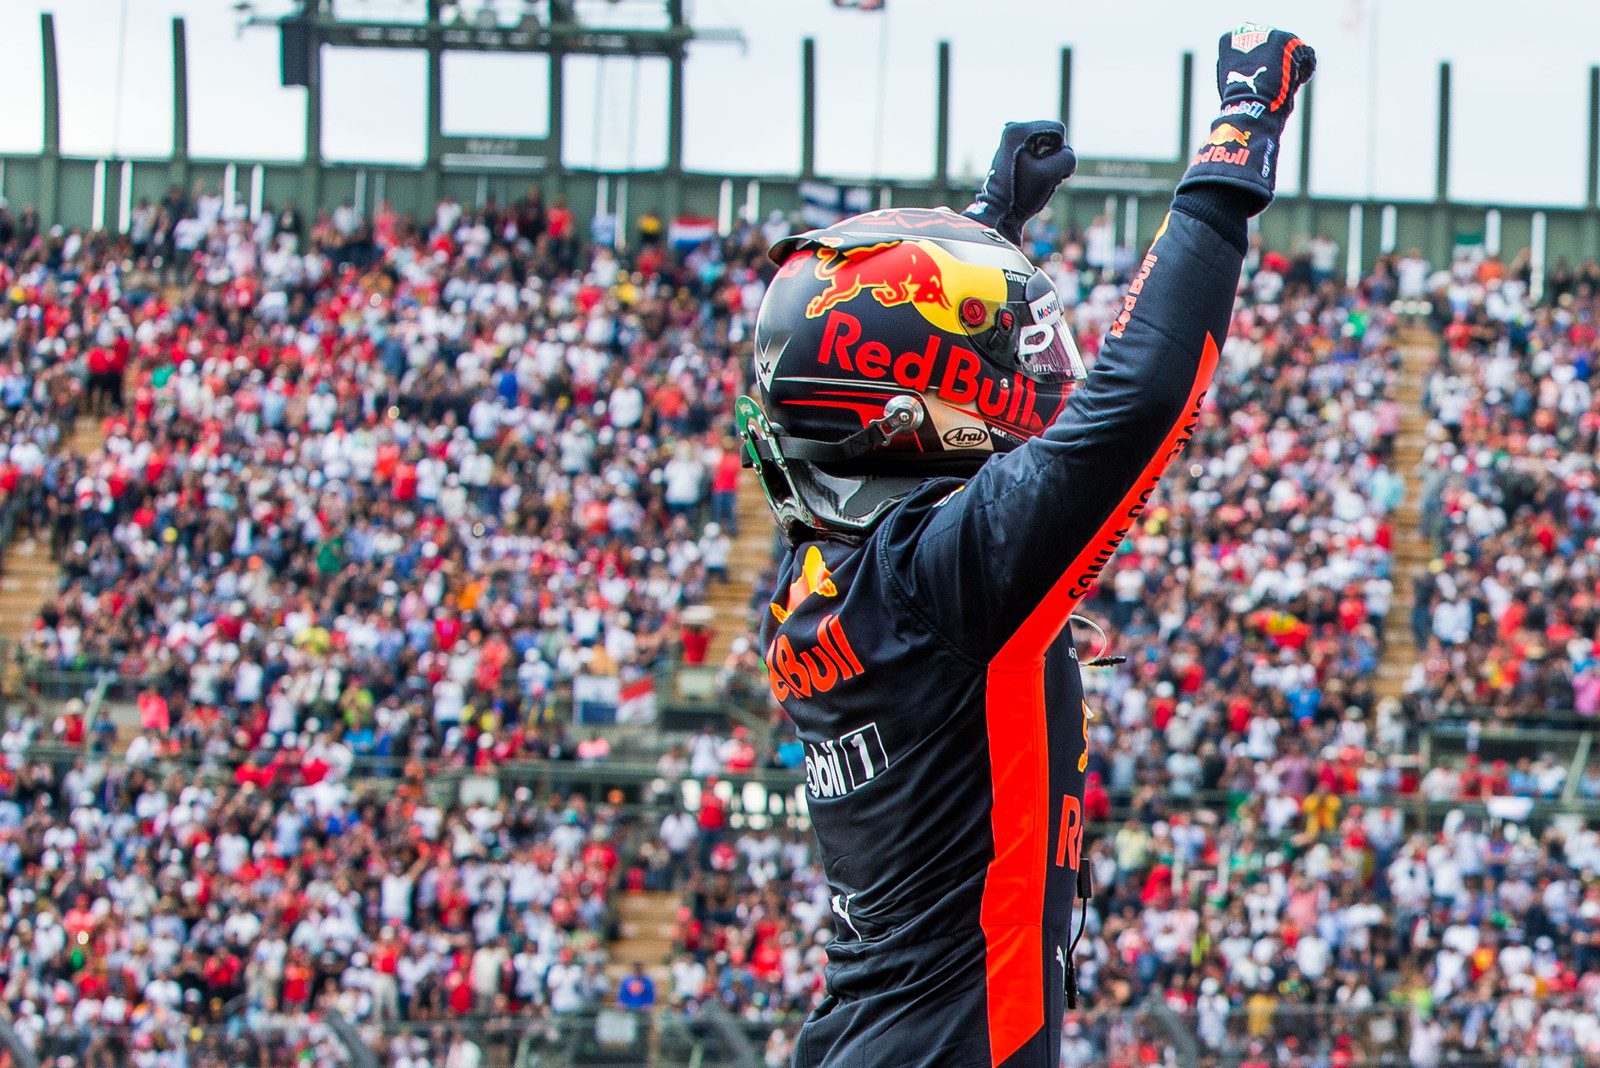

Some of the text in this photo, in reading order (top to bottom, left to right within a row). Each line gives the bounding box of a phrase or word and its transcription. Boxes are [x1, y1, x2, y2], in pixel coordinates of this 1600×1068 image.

[1214, 146, 1250, 166] Bull
[1110, 253, 1158, 338] Red Bull
[818, 310, 1037, 428] Red Bull
[946, 429, 983, 442] Arai
[775, 613, 865, 698] Bull
[805, 740, 847, 799] obil
